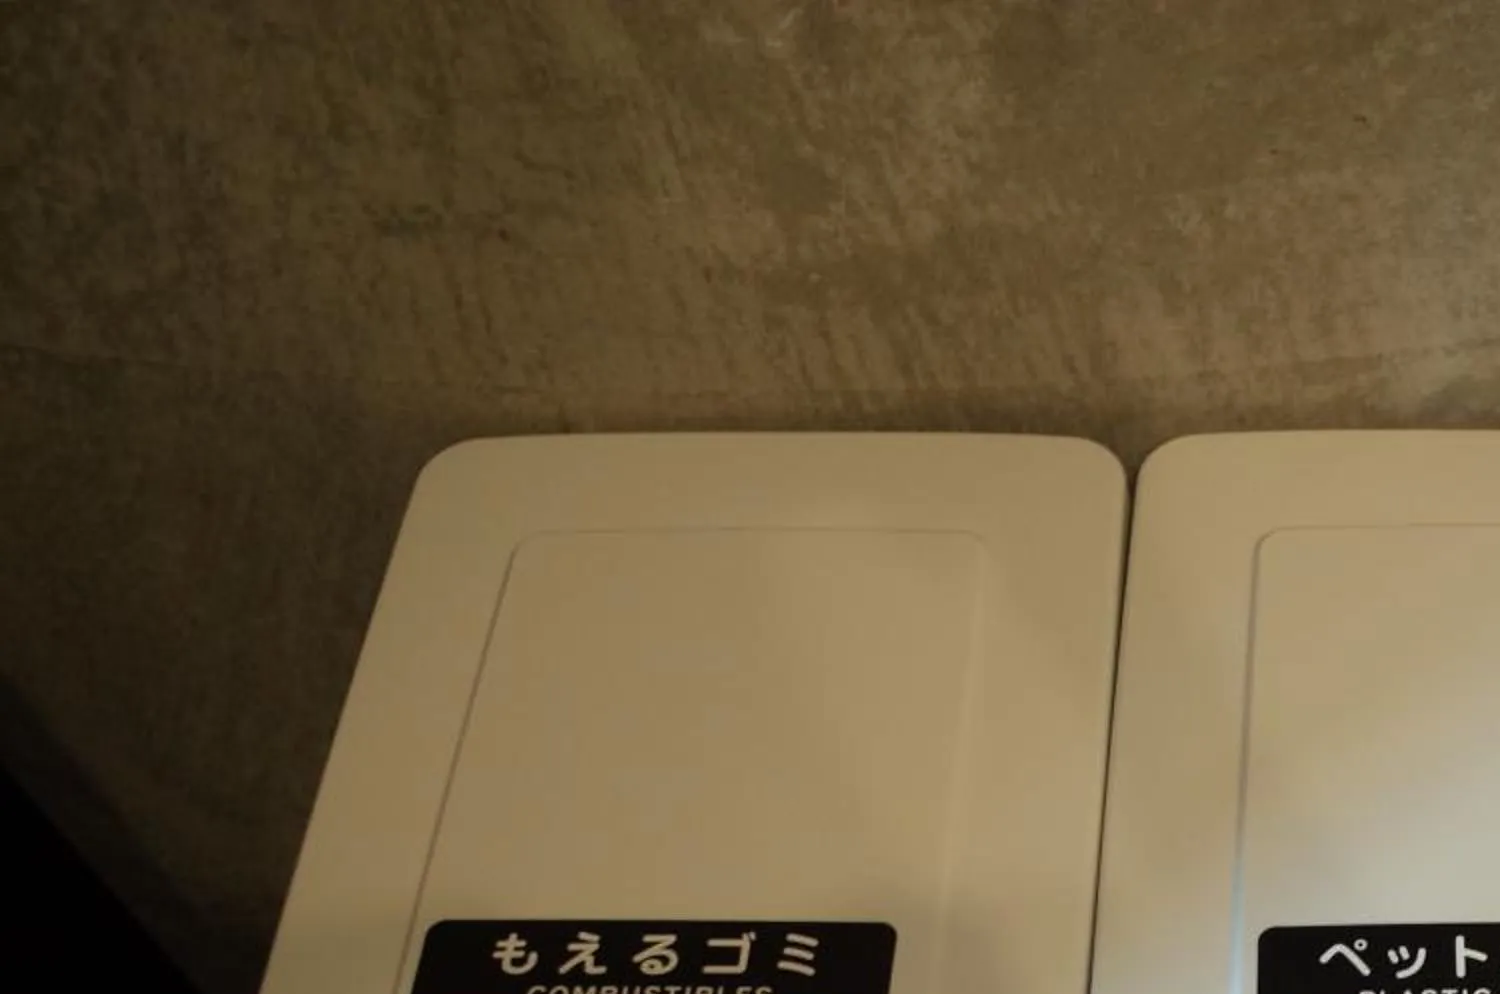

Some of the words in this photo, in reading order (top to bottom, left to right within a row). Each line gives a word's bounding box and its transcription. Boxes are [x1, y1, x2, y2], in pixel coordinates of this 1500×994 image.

[492, 931, 819, 977] もえるゴミ
